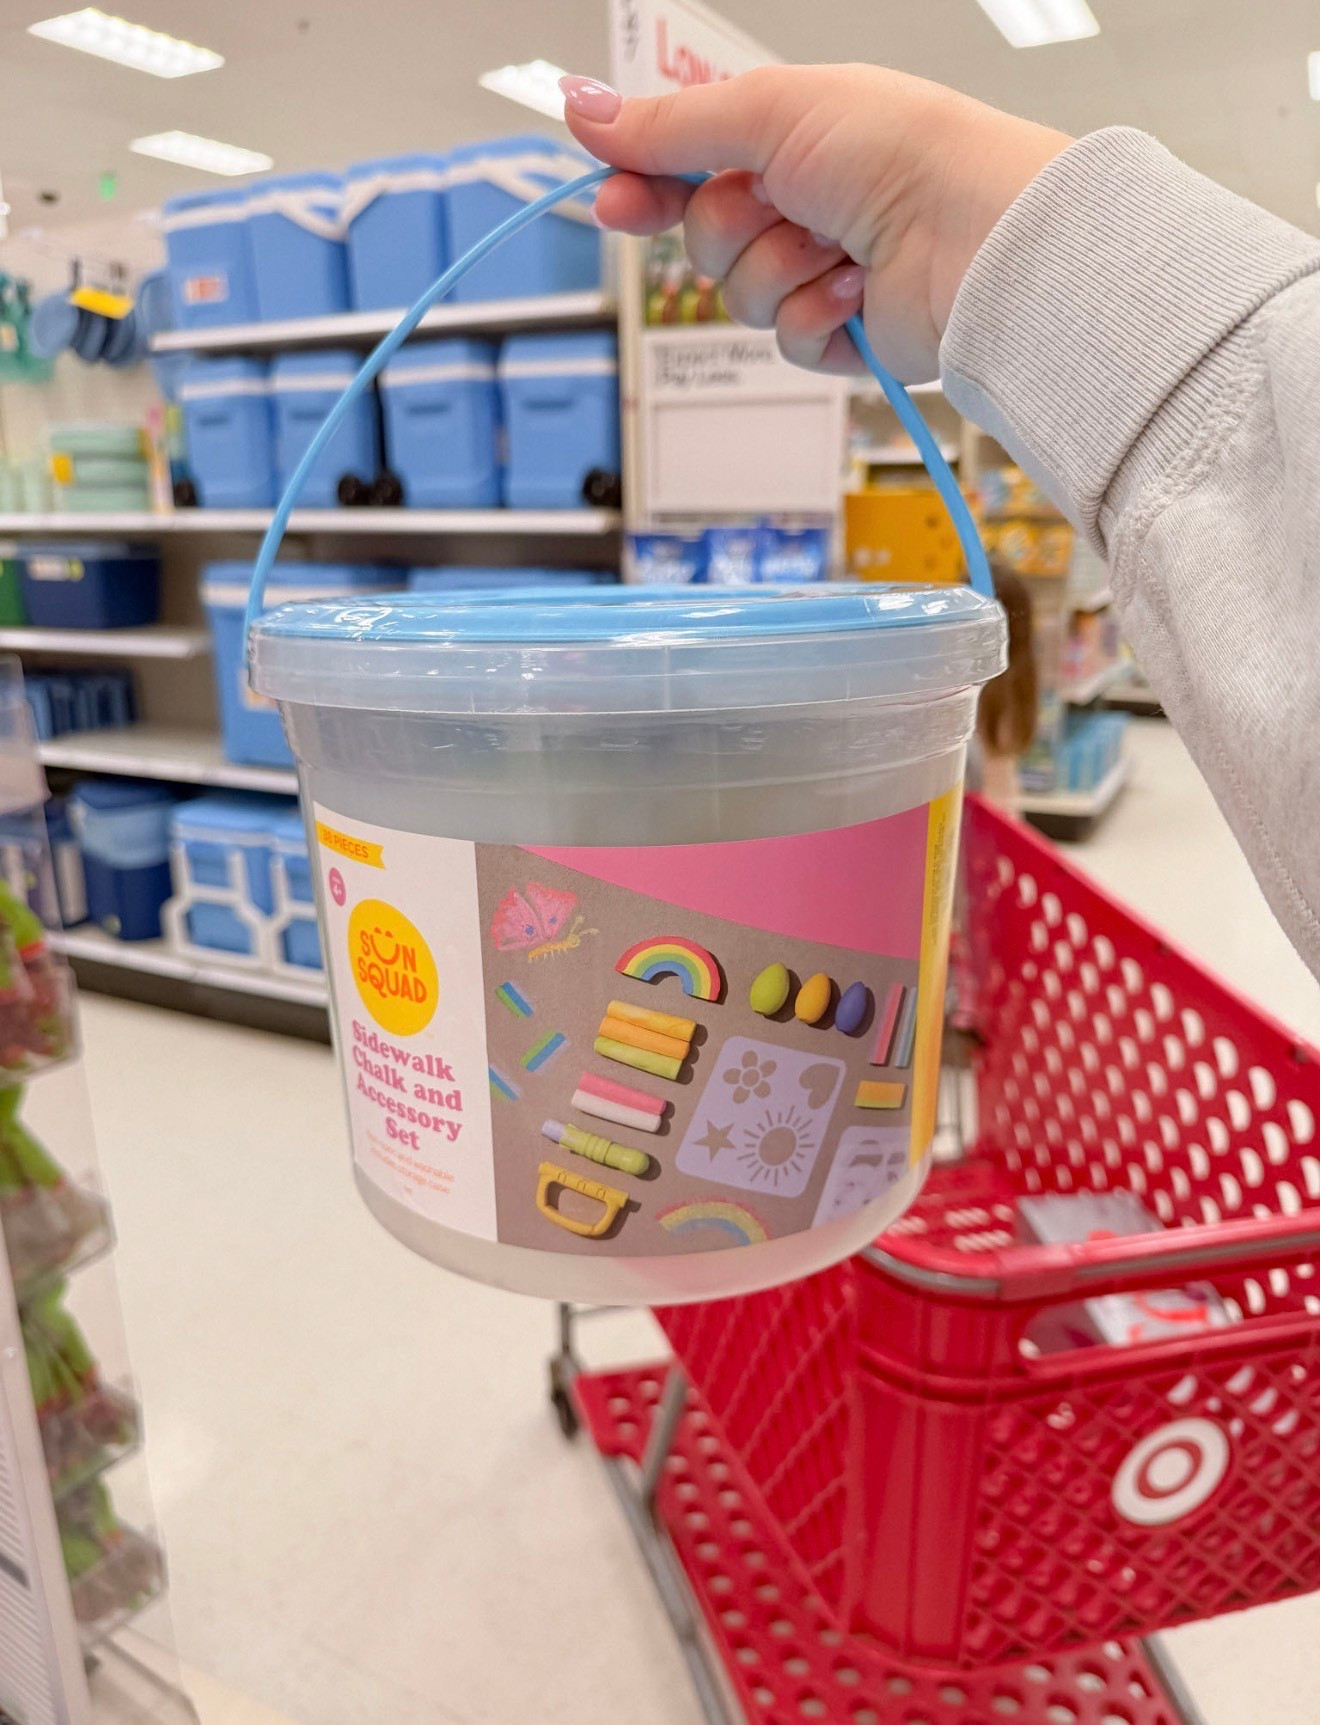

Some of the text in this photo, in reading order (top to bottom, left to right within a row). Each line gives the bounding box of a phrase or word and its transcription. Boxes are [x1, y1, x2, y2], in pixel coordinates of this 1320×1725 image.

[333, 834, 370, 860] PIECES
[359, 926, 418, 974] SUN
[357, 955, 428, 1004] SQUAD
[352, 1019, 456, 1082] Sidewalk
[352, 1045, 463, 1112] Chalk and
[357, 1071, 463, 1142] Accessory
[385, 1116, 420, 1151] Set
